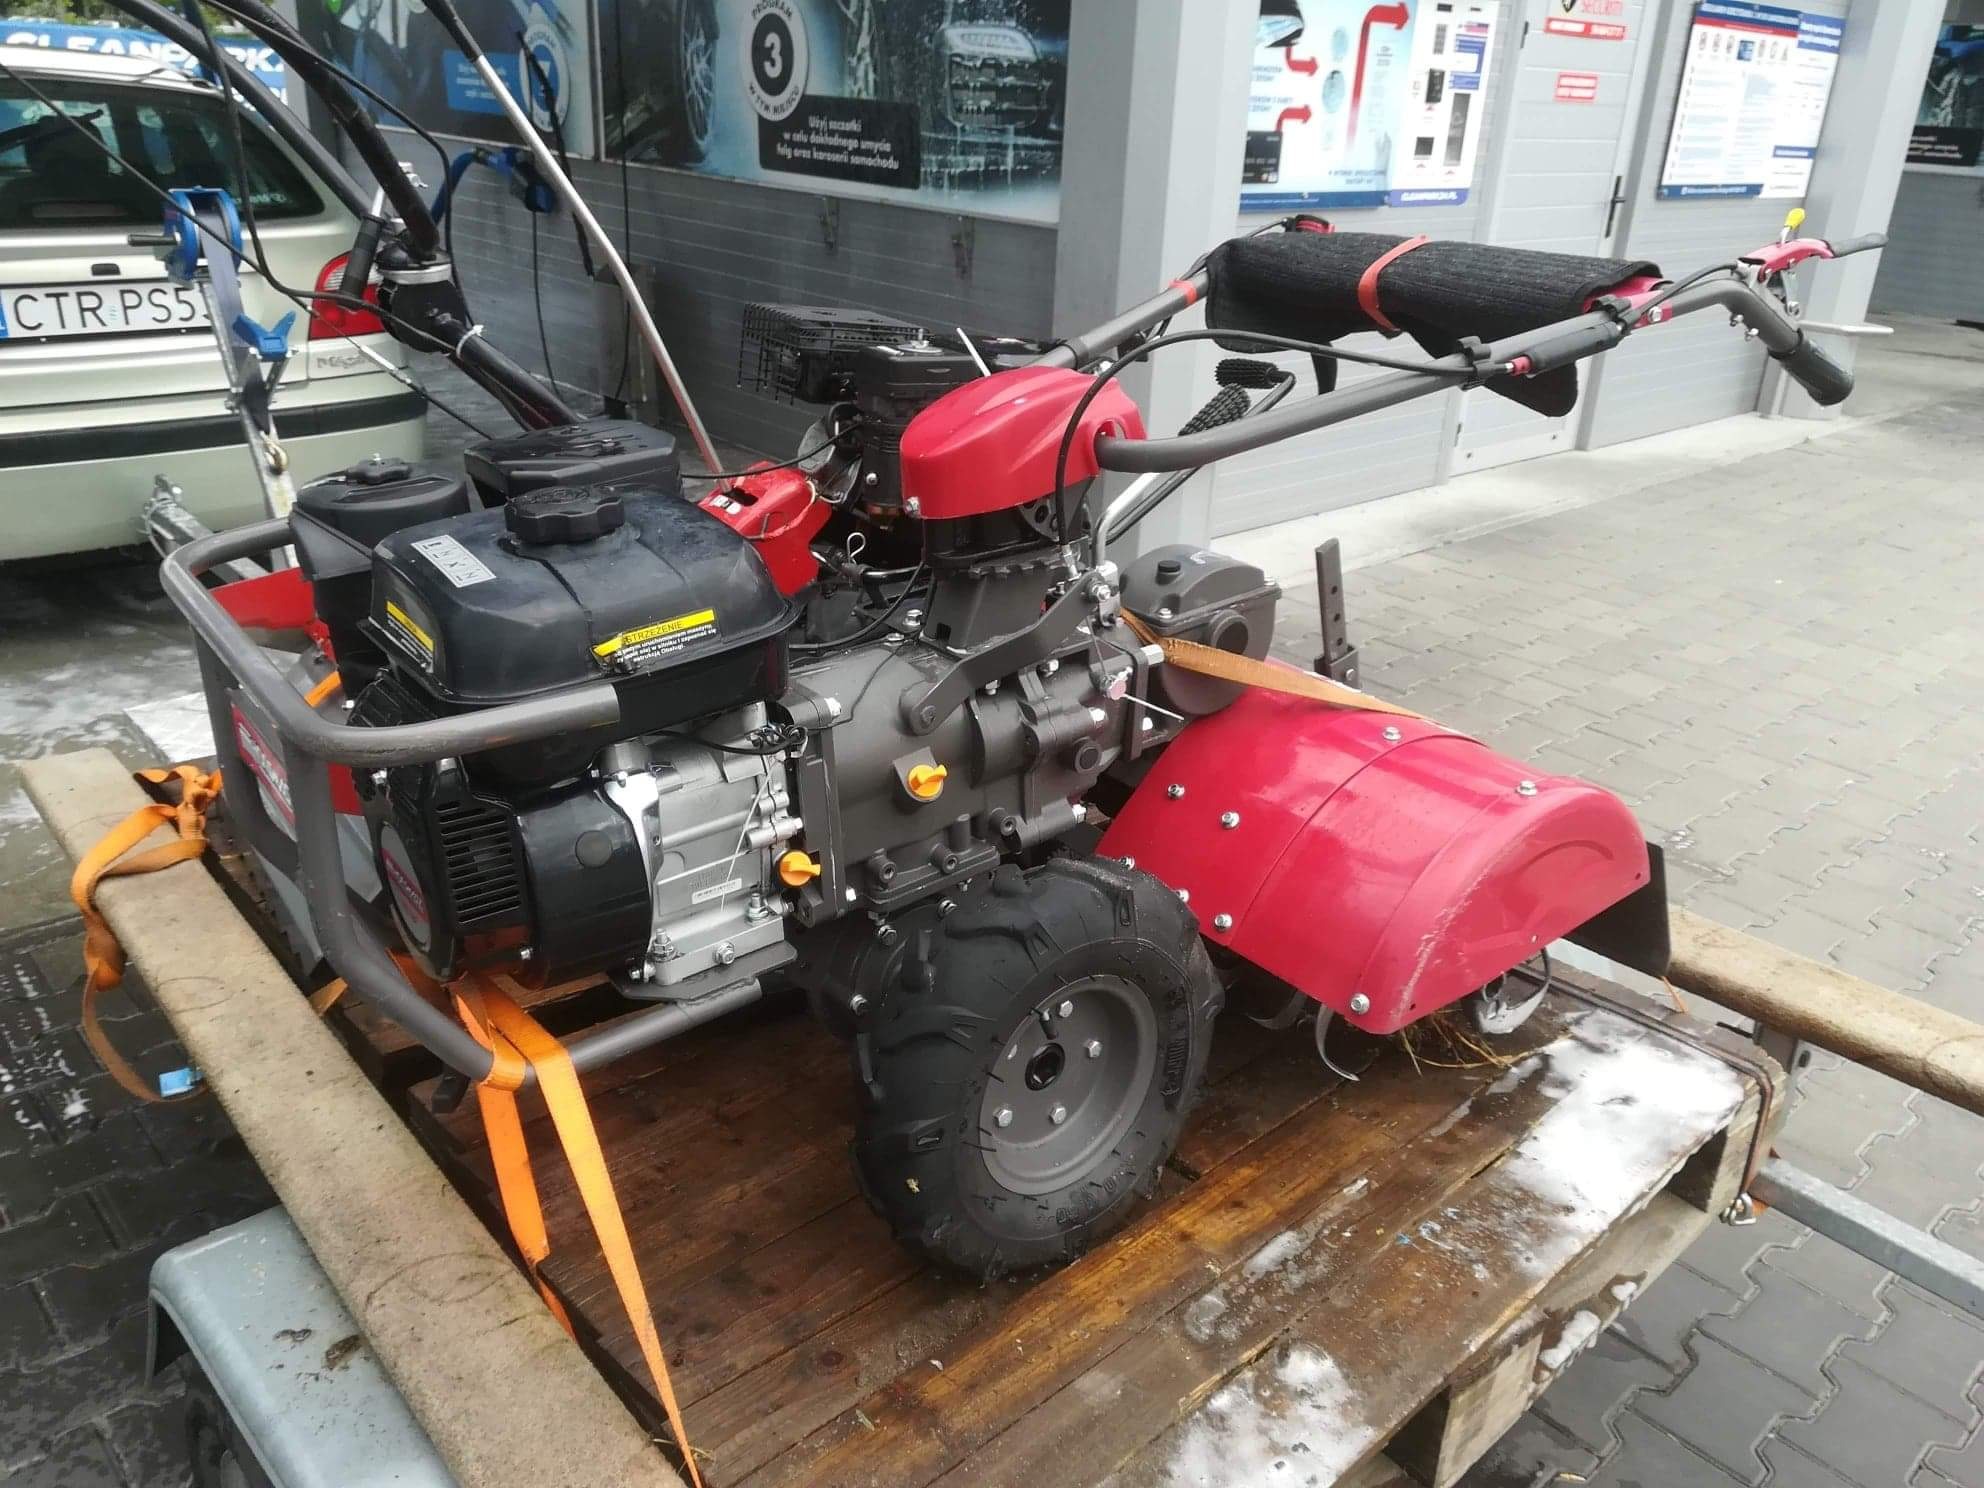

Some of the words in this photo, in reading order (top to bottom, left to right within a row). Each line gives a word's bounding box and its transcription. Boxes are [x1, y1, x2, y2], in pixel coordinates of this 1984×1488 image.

[763, 32, 783, 79] 3
[792, 130, 808, 143] celu
[860, 139, 891, 153] umycia
[793, 148, 811, 158] oraz
[812, 146, 849, 162] karoserii
[850, 153, 899, 170] samochodu
[13, 291, 107, 331] CTR
[119, 285, 211, 326] PS5
